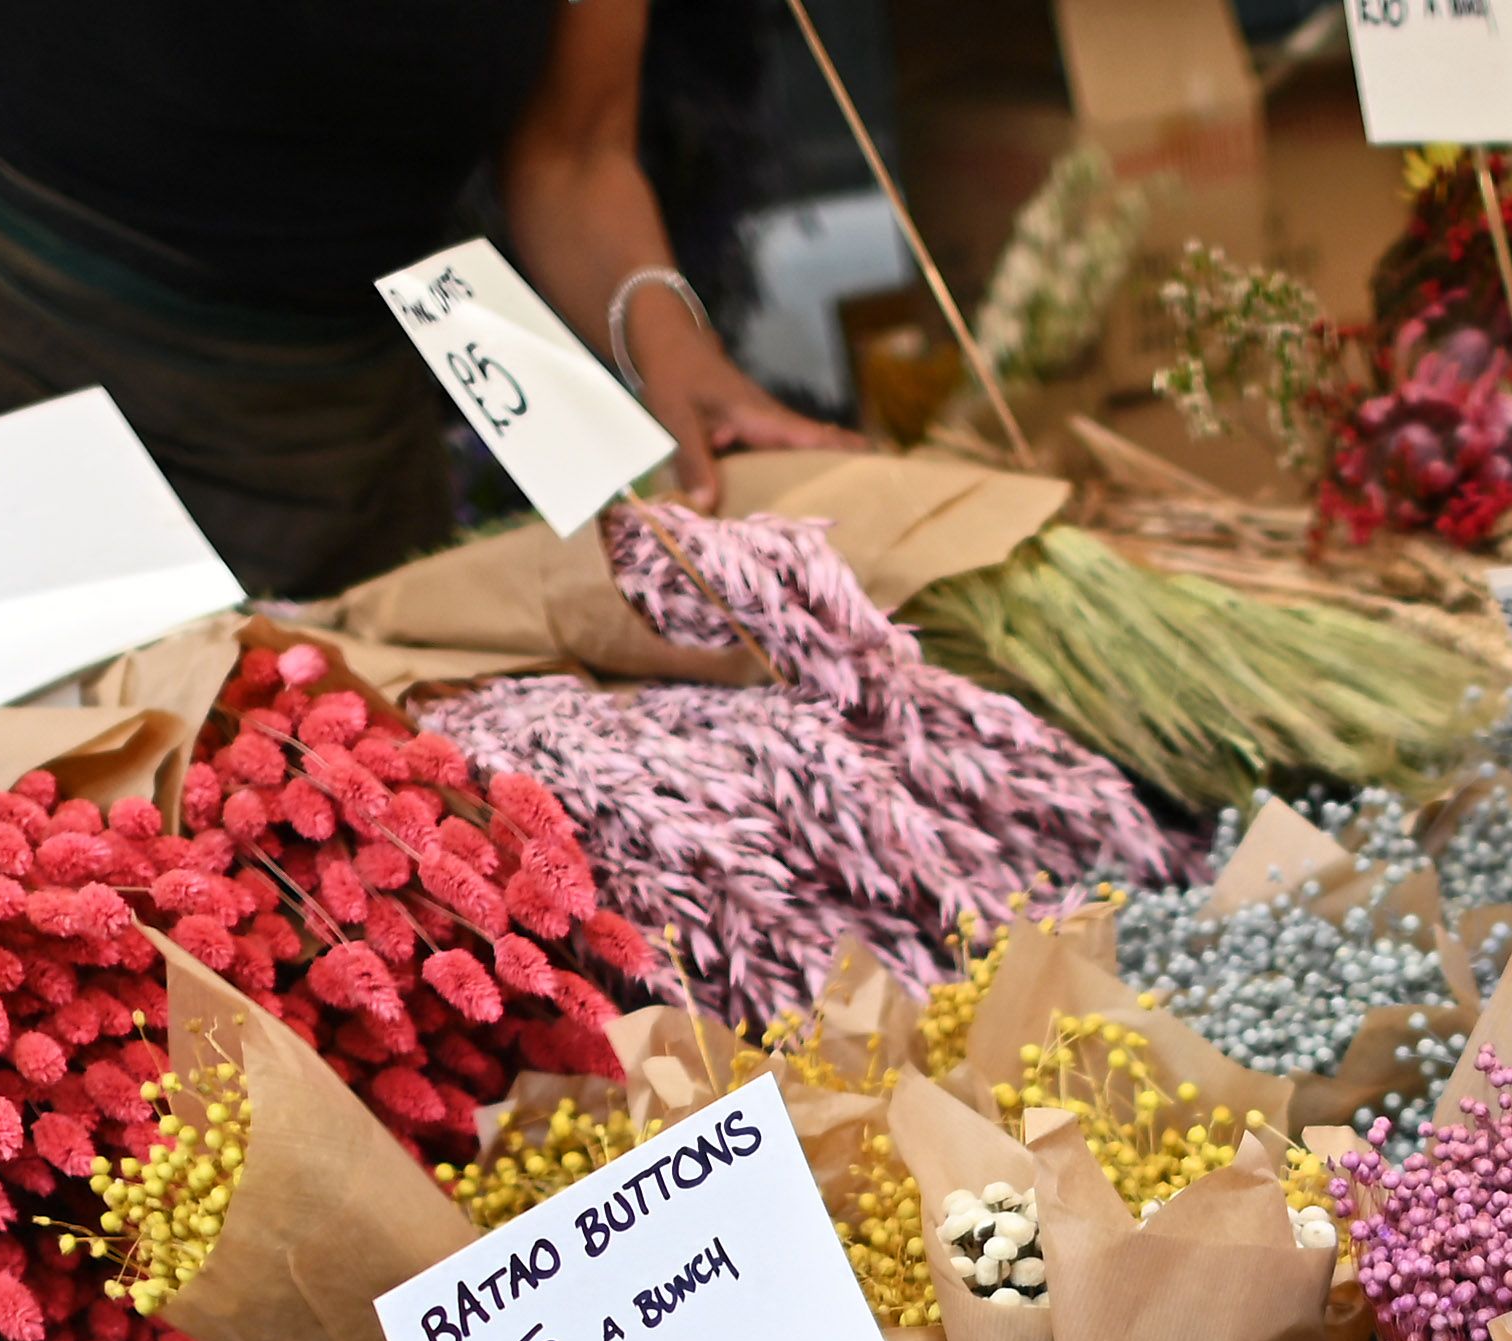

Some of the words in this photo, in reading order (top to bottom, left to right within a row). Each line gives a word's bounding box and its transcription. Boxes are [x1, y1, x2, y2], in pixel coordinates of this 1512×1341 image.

[446, 342, 527, 437] £5
[575, 1110, 762, 1257] BUTTONS
[633, 1237, 740, 1328] BUNCH
